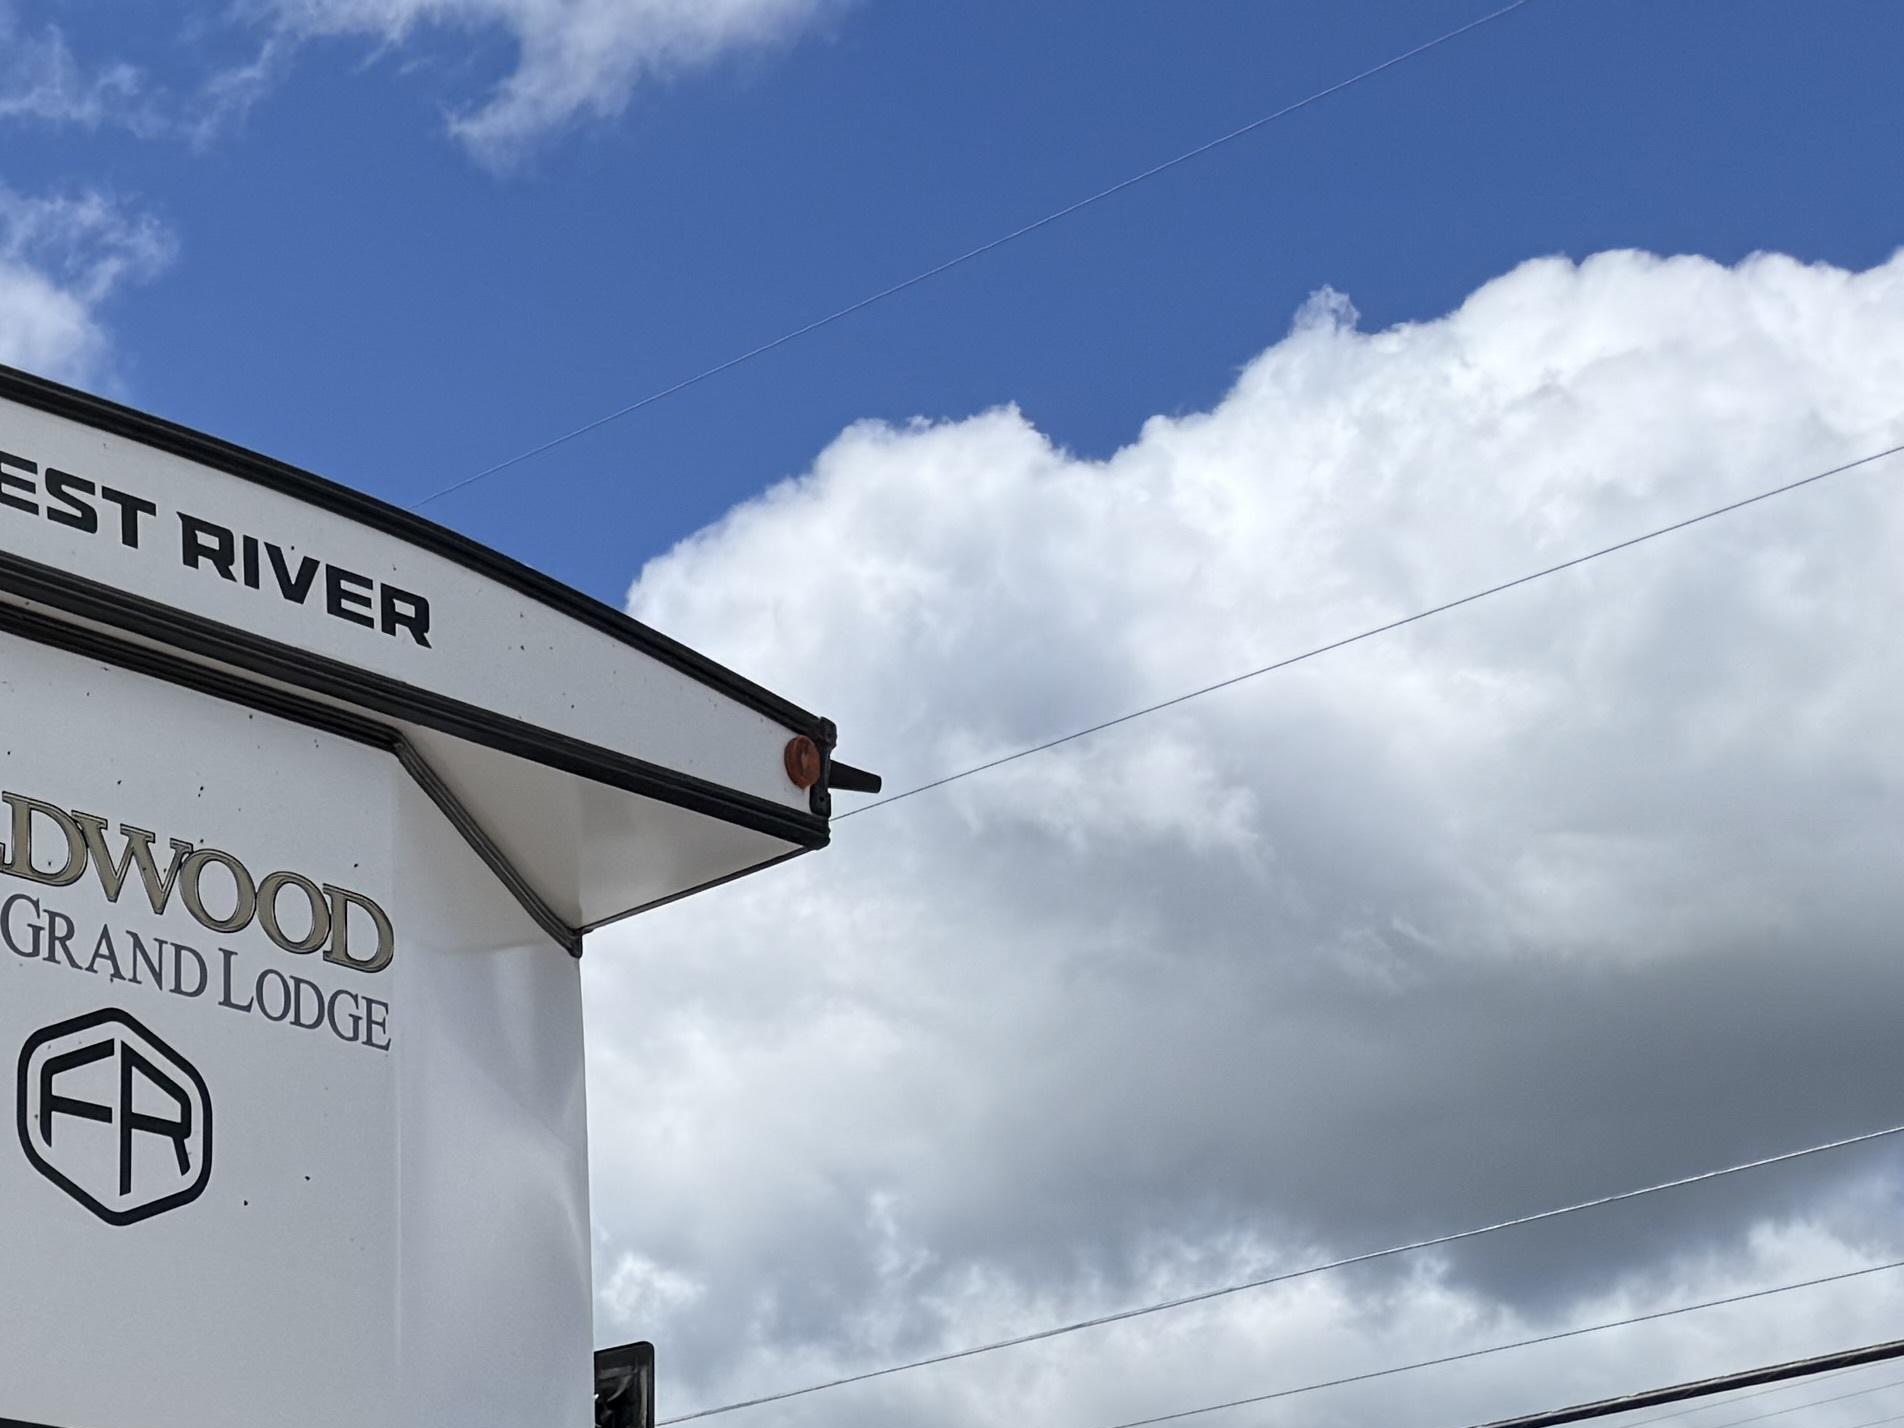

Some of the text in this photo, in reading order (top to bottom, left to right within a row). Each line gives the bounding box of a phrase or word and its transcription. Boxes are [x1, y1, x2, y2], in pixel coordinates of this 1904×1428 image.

[176, 511, 432, 649] RIVER
[0, 892, 392, 1052] GRAND LODGE
